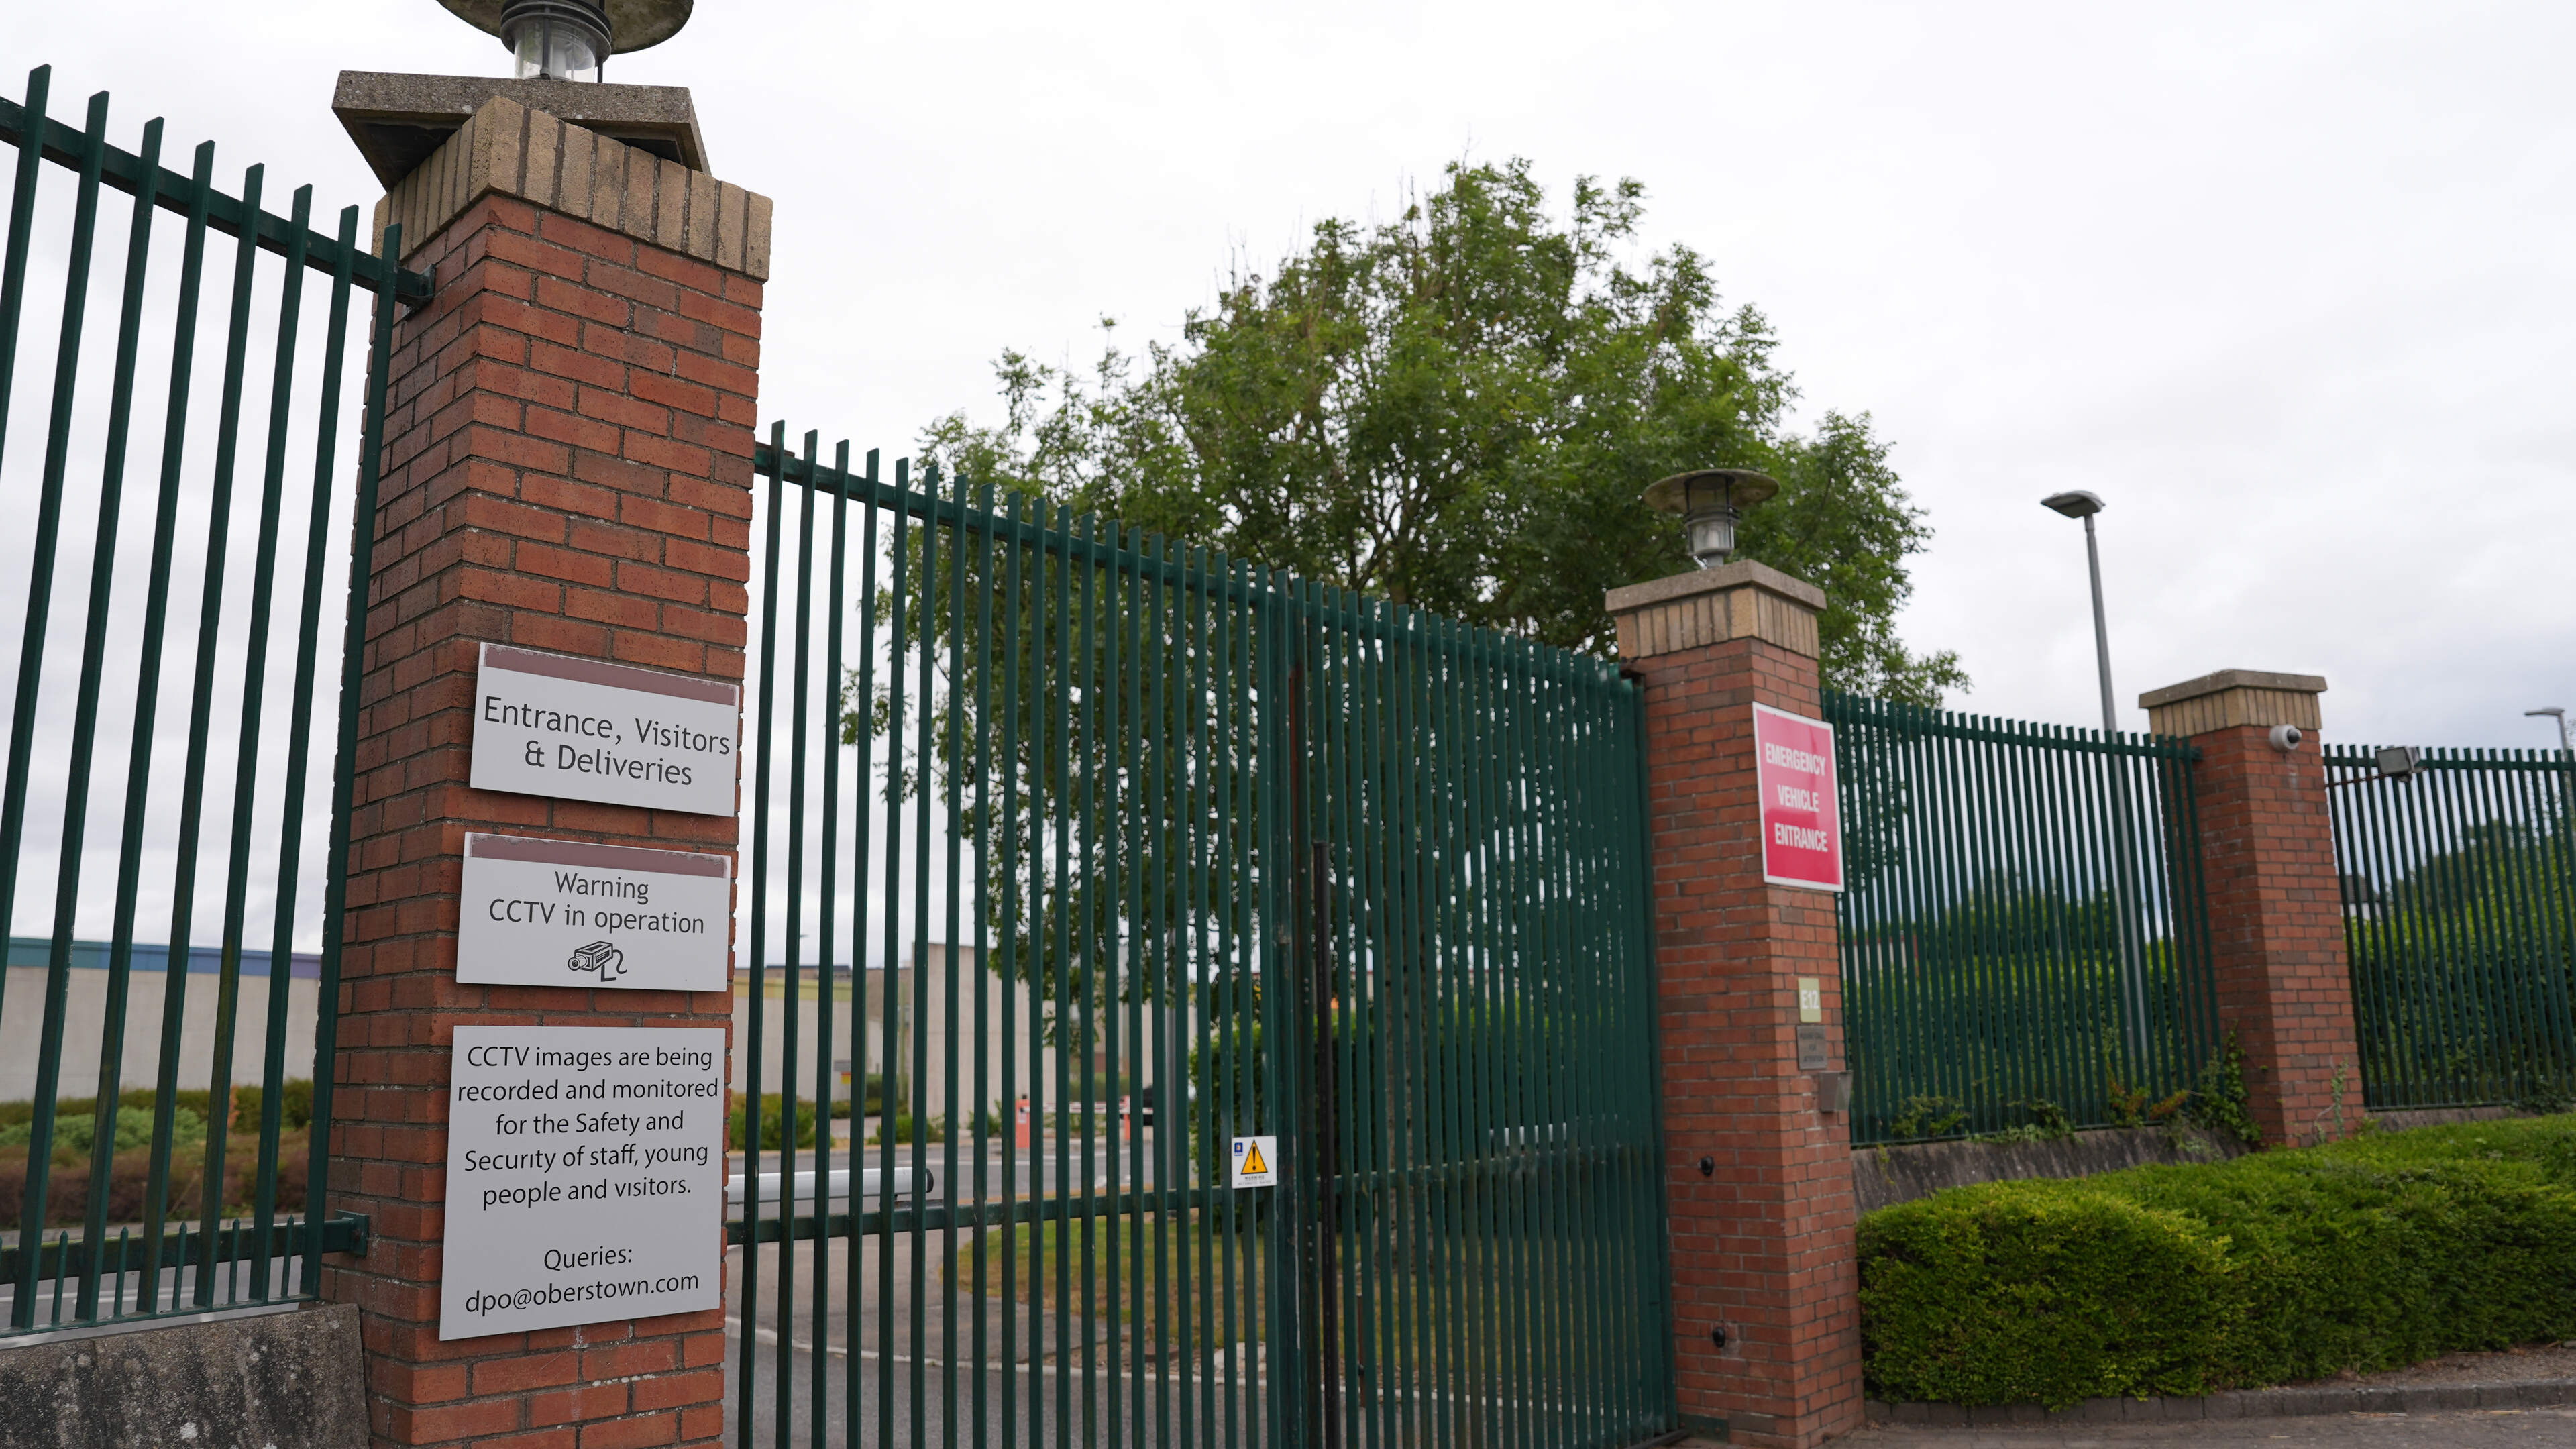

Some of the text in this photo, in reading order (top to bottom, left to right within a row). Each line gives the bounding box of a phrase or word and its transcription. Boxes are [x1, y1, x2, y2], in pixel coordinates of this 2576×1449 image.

[485, 696, 729, 754] Entrance, Visitors
[525, 741, 691, 785] & Deliveries
[1766, 743, 1826, 776] EMERGENCY
[1777, 784, 1819, 812] VEHICLE
[1775, 823, 1828, 852] ENTRANCE
[555, 871, 648, 904] Warning
[490, 899, 703, 934] CCTV in operation
[1801, 989, 1819, 1010] E12
[468, 1046, 711, 1071] CCTV images are being
[459, 1078, 717, 1101] recorded and monitored
[496, 1110, 683, 1136] for the Safety and
[465, 1144, 707, 1173] Security of staff, young
[484, 1178, 690, 1211] people and visitors.
[544, 1246, 631, 1271] Queries:
[466, 1275, 698, 1316] dpo@oberstown.com
